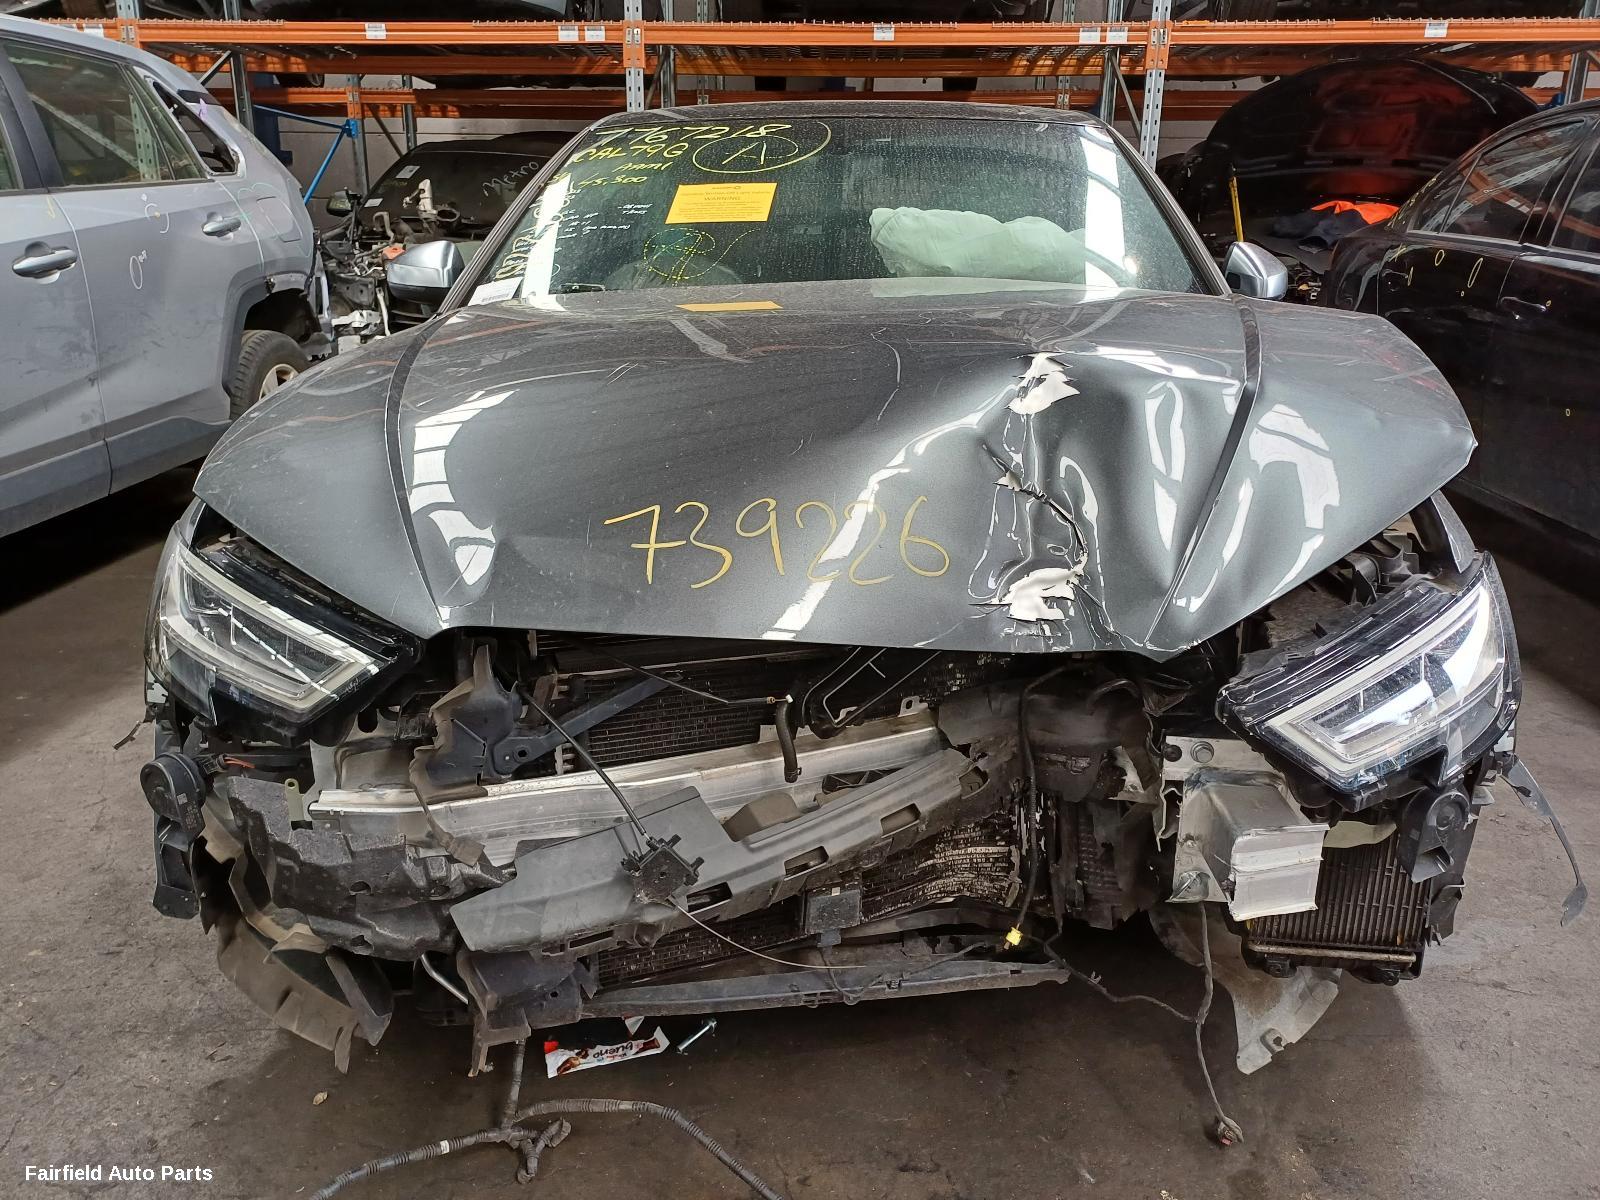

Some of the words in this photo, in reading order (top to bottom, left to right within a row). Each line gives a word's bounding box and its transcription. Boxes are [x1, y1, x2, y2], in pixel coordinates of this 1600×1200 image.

[595, 124, 792, 147] 7767218
[482, 161, 540, 197] Metro
[603, 495, 950, 589] 739226
[592, 1041, 634, 1059] bueno
